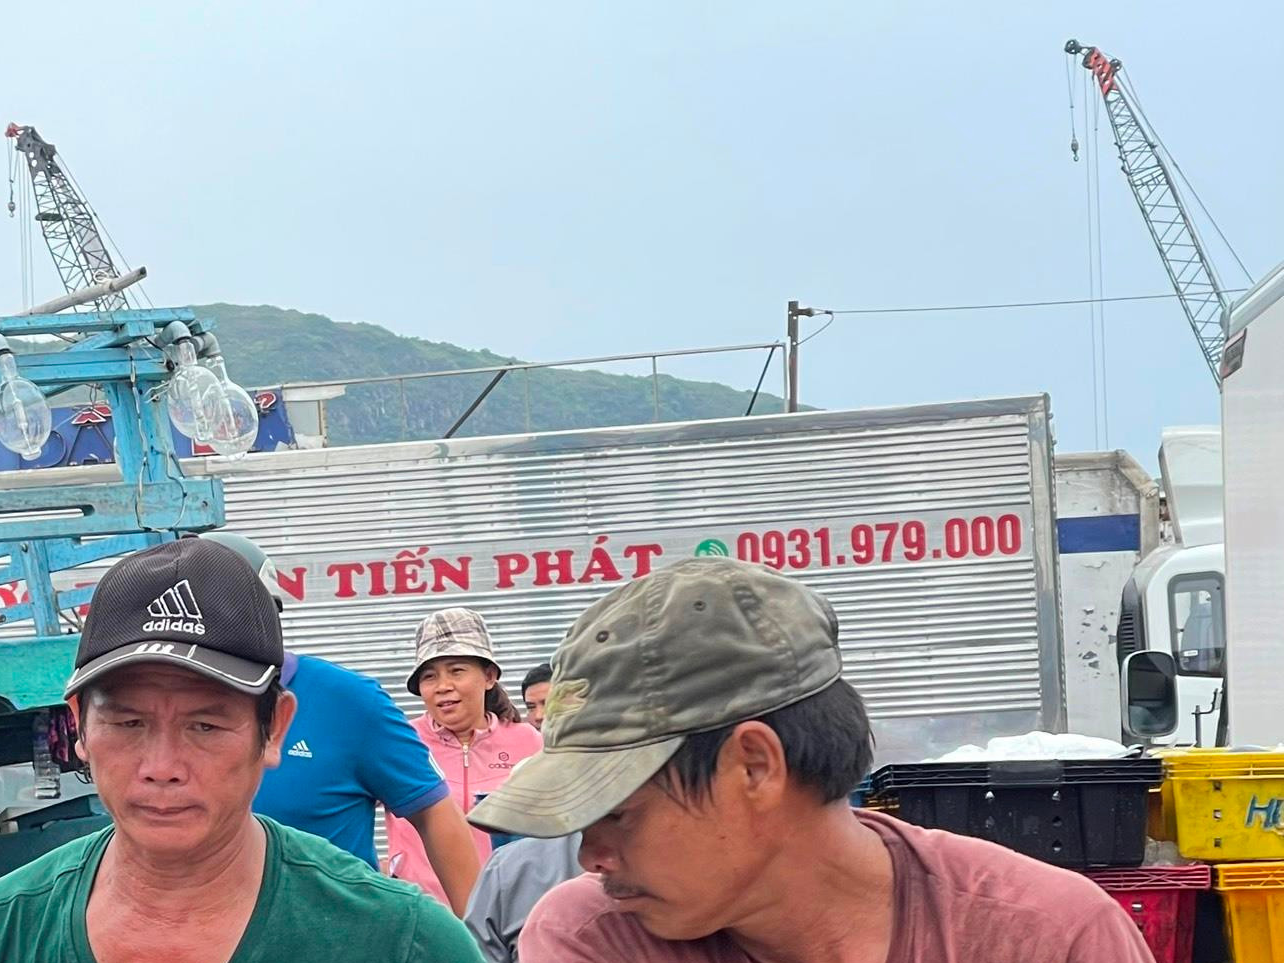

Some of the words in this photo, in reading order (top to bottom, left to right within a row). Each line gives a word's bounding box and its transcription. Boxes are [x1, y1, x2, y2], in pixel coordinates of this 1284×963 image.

[327, 546, 473, 598] TIẾN
[493, 535, 664, 590] PHÁT
[736, 513, 1022, 571] 0931.979.000
[142, 618, 206, 635] adidas
